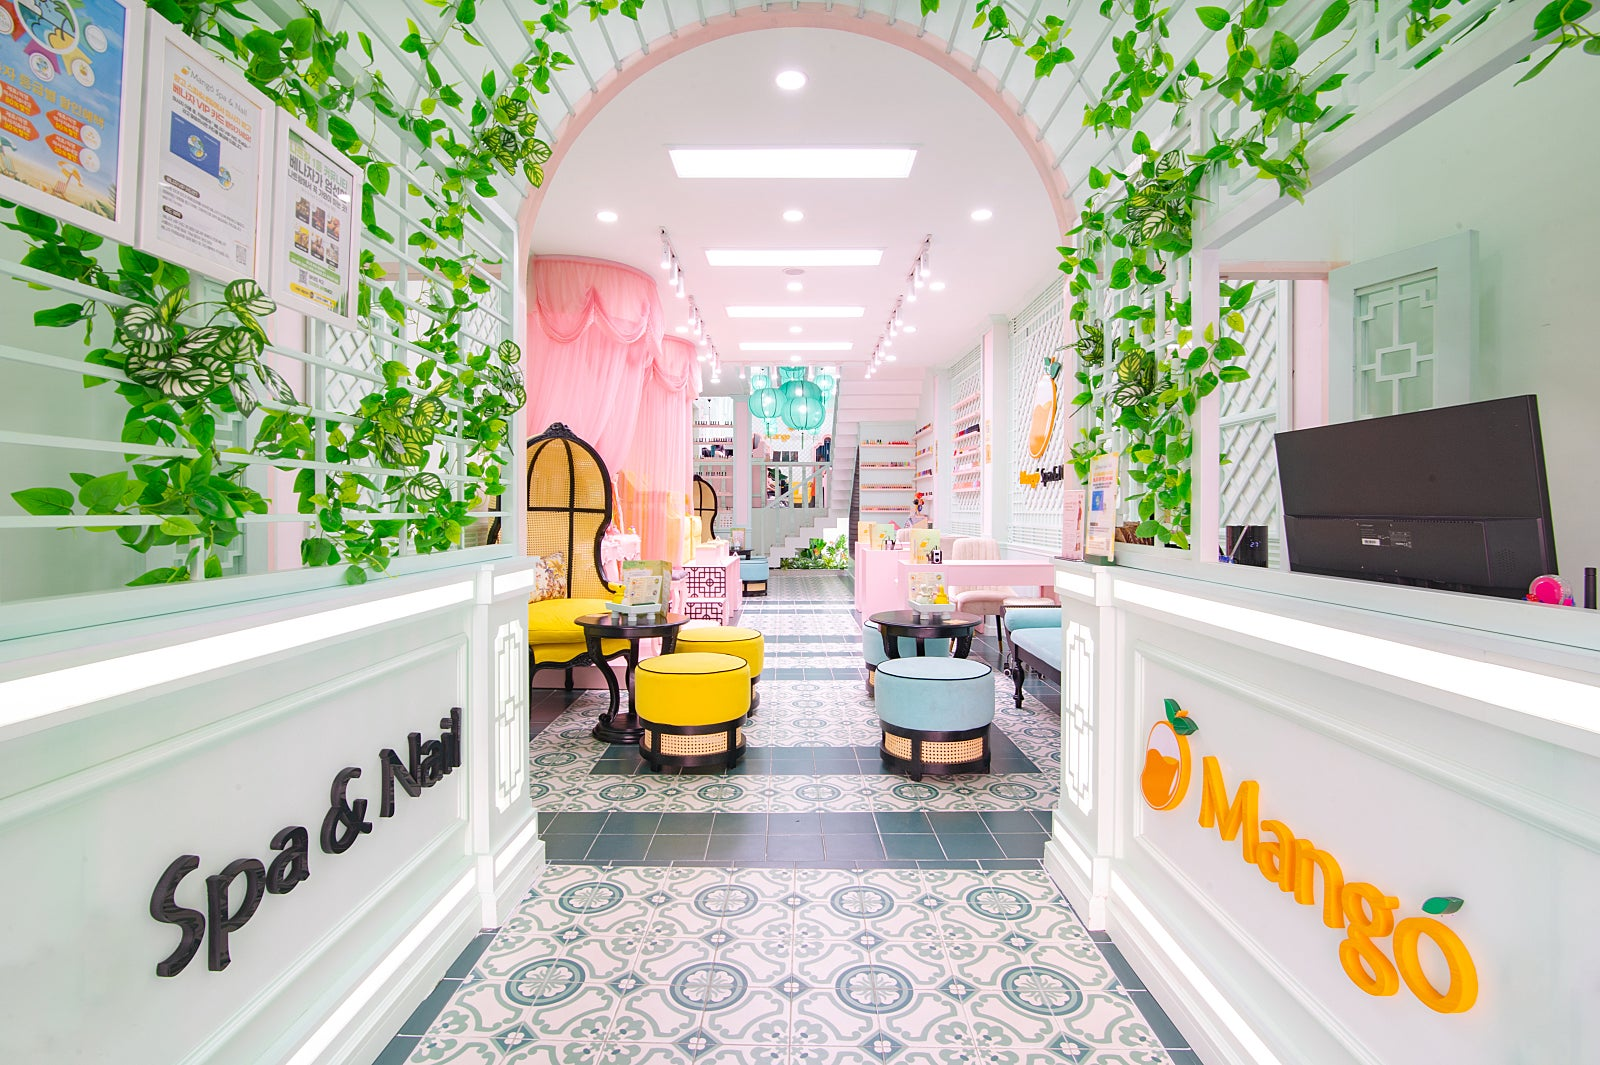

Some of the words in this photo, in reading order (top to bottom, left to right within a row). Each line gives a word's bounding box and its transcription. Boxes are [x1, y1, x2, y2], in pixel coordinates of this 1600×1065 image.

[173, 82, 195, 106] 베나자
[196, 98, 210, 113] VIP
[211, 109, 225, 126] 카드
[190, 71, 214, 93] Mango
[216, 88, 227, 102] Spa
[236, 103, 248, 117] Nail
[289, 153, 323, 188] 베나자가
[150, 825, 310, 977] Spa
[320, 766, 373, 854] &
[378, 707, 462, 818] Nail
[1198, 755, 1479, 1014] Mango
